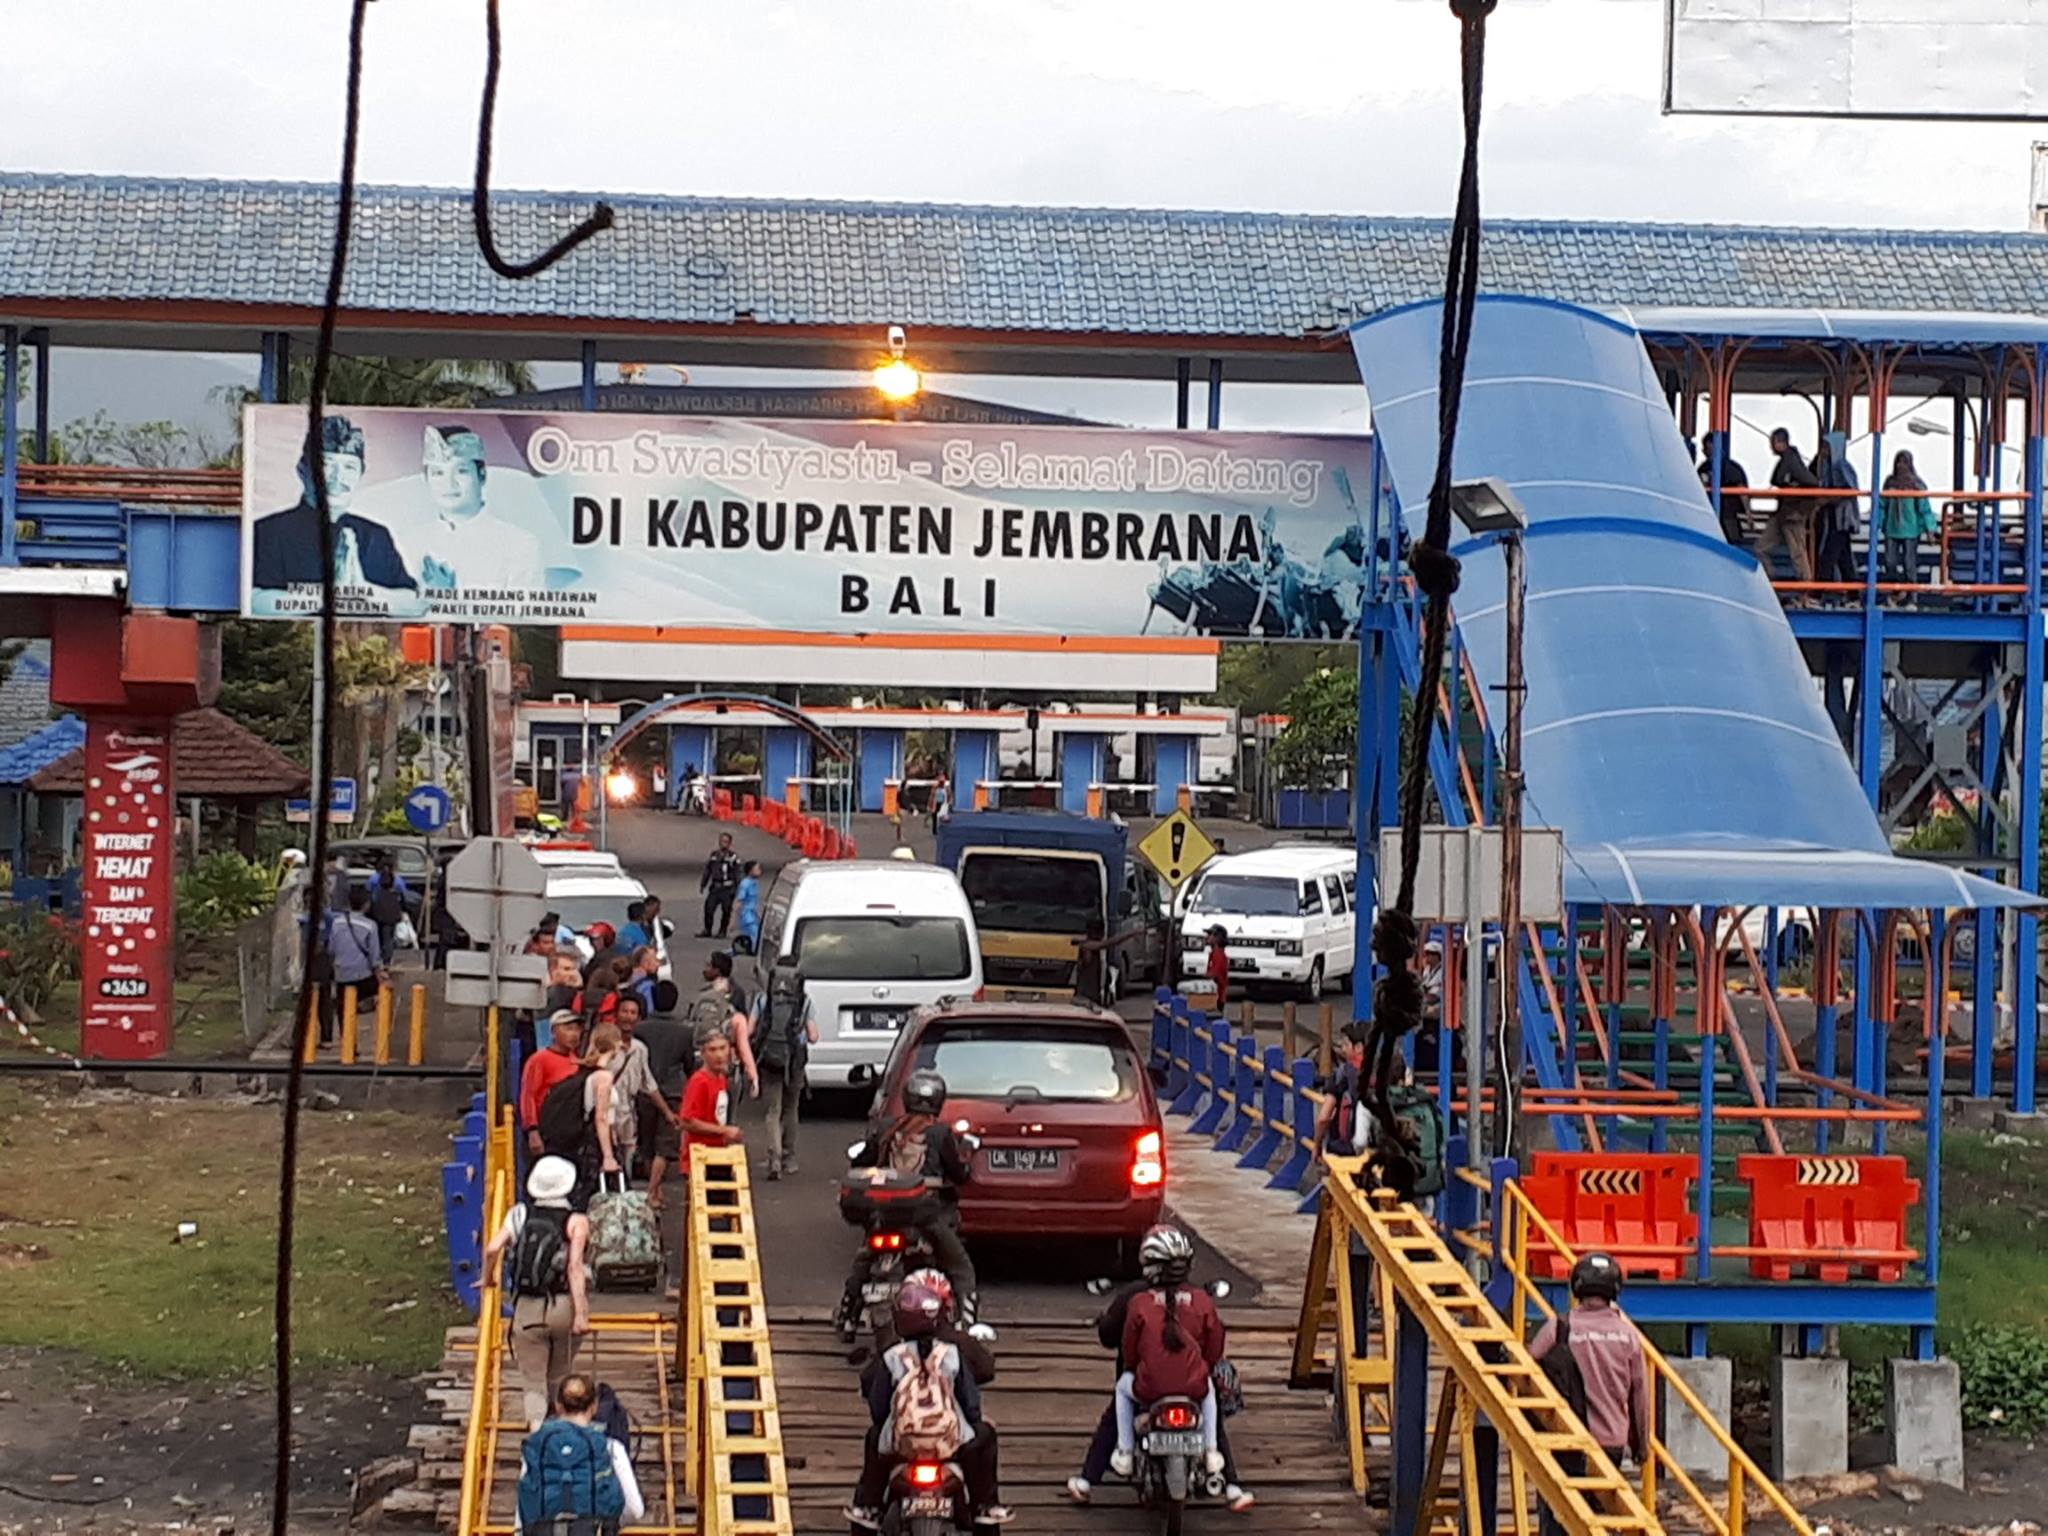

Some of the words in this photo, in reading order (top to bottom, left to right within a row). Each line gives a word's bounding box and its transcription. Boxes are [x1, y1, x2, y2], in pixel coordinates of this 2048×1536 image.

[526, 426, 618, 477] Om
[633, 431, 900, 492] Swastyastu
[942, 441, 1141, 492] Selamat
[1147, 447, 1323, 506] Datang
[573, 497, 621, 546] DI
[648, 501, 952, 556] KABUPATEN
[974, 506, 1262, 563] JEMBRANA
[275, 599, 320, 611] BUPATI
[424, 588, 458, 600] MADE
[463, 589, 525, 602] KEMBANG
[529, 590, 598, 604] HARTAWAN
[841, 575, 996, 617] BALI
[431, 603, 468, 616] WAKIL
[473, 604, 516, 617] BUPATI
[520, 605, 587, 618] JEMBRANA
[93, 833, 155, 851] INTERNET
[94, 856, 153, 879] HEMAT
[109, 885, 136, 902] DAN
[91, 906, 154, 924] TERCEPAT
